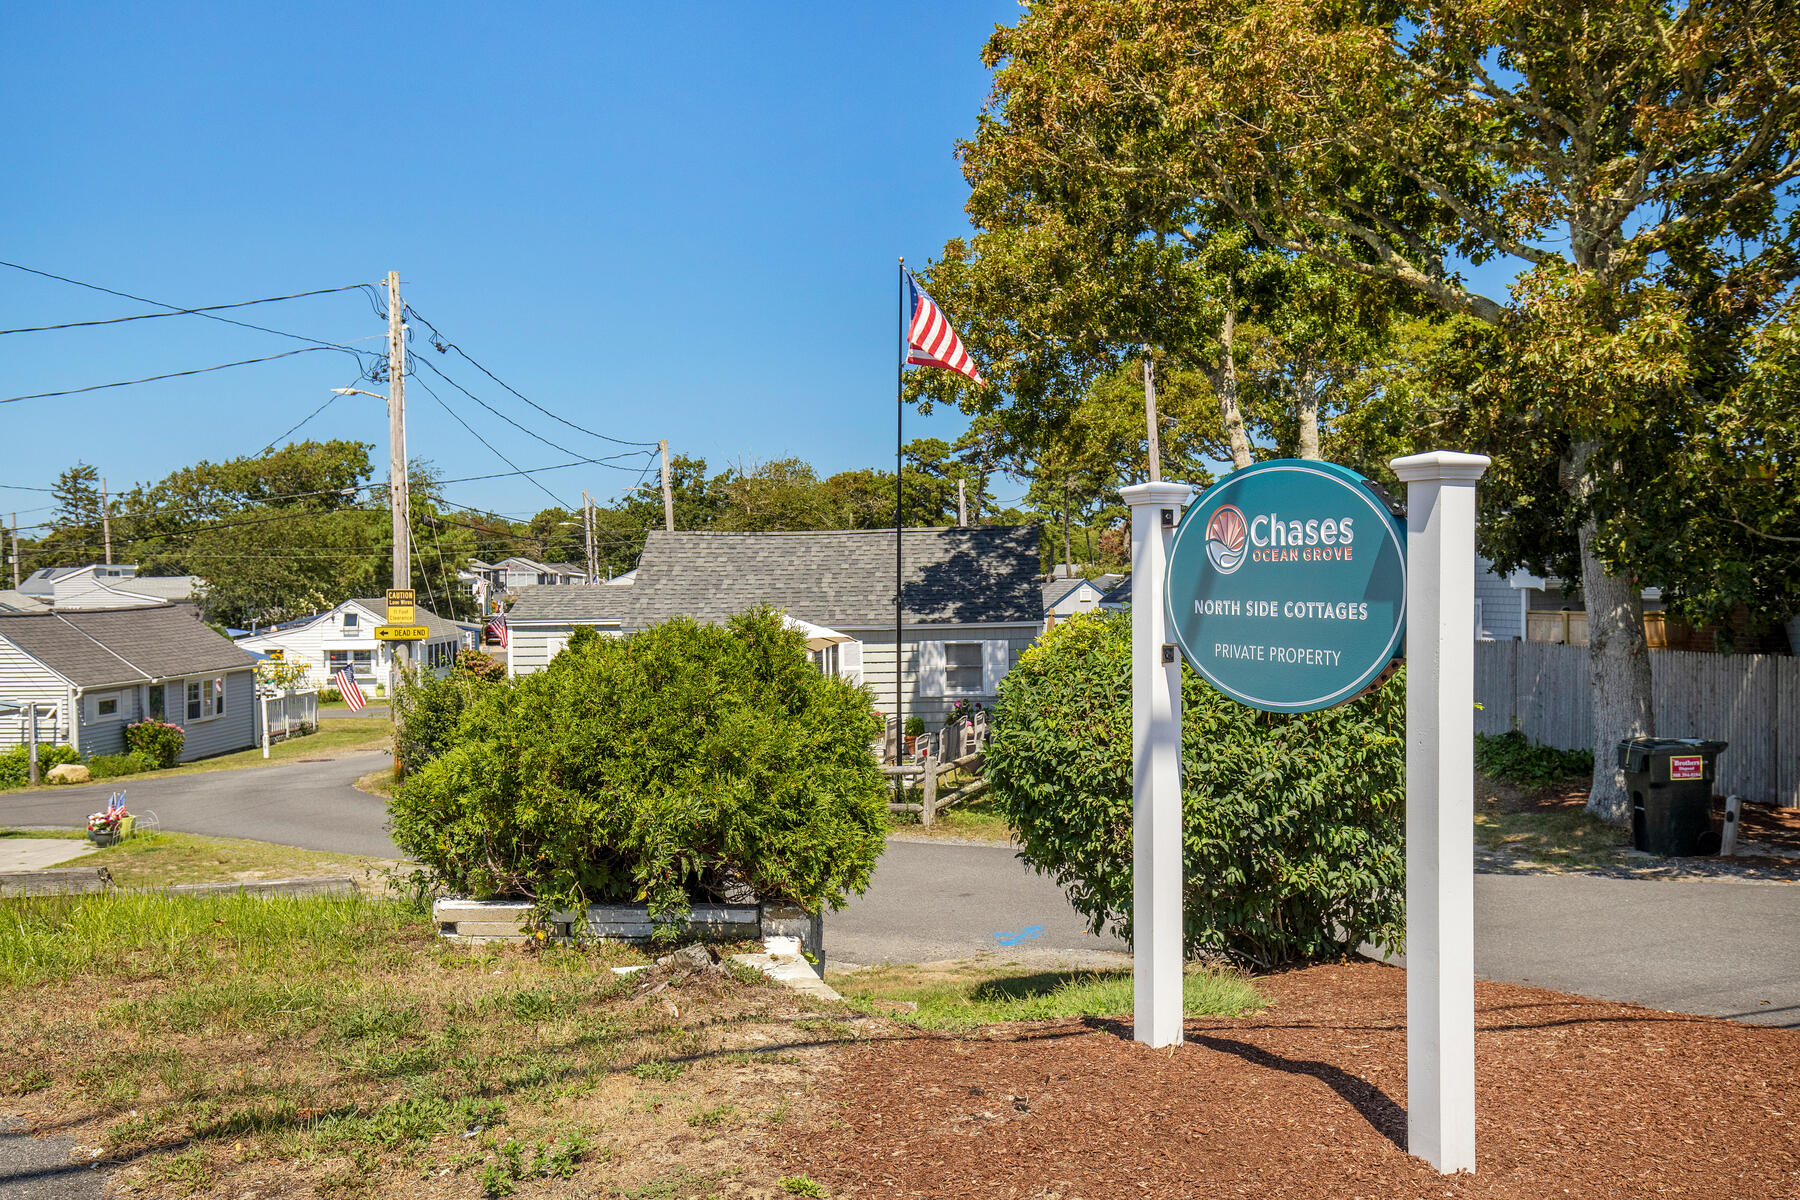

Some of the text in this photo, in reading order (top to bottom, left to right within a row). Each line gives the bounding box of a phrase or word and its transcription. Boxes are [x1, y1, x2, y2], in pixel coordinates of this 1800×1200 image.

[1250, 513, 1354, 547] Chases
[1252, 546, 1353, 562] OCEAN GROVE
[1194, 600, 1368, 620] NORTH SIDE COTTAGES
[1215, 643, 1342, 667] PRIVATE PROPERTY
